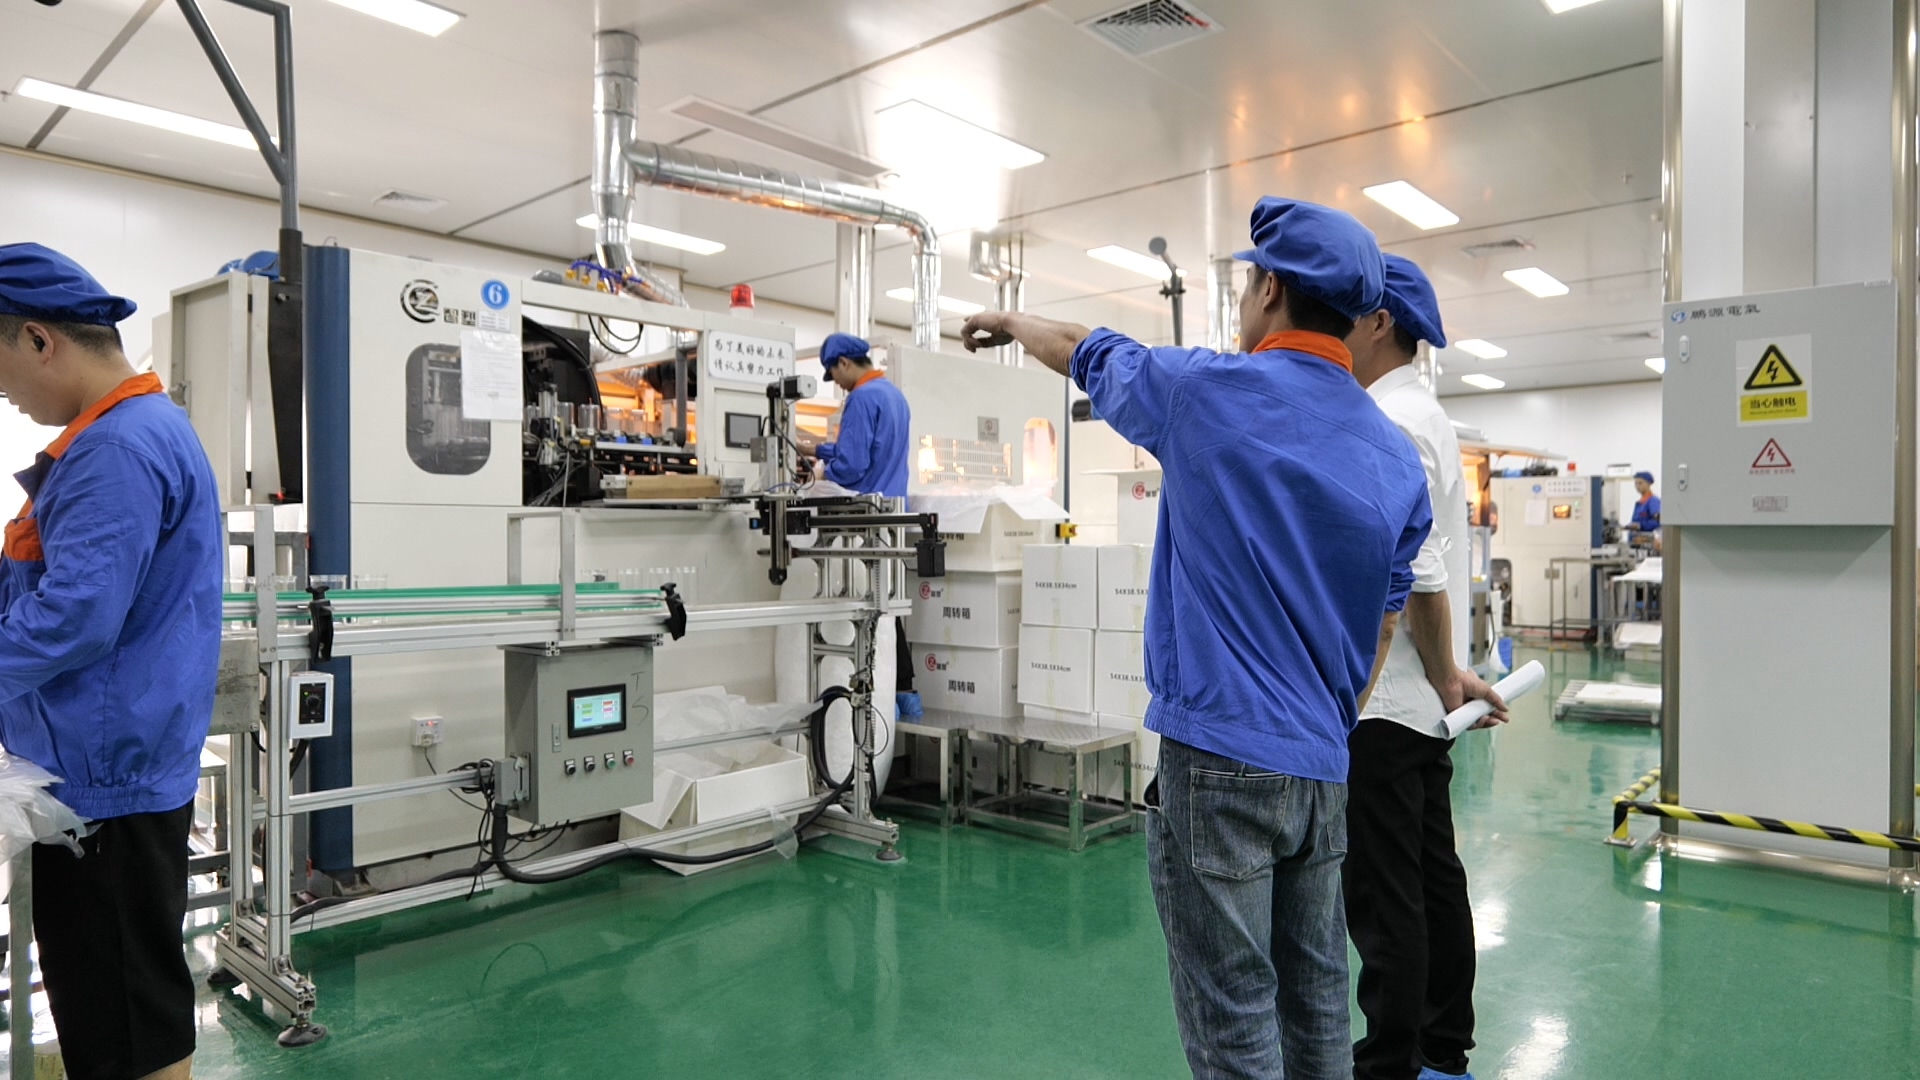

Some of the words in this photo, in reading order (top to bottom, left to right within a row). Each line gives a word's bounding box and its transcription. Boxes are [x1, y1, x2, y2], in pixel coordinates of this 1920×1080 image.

[487, 283, 503, 304] 6
[1750, 396, 1796, 409] 当心触电
[942, 606, 971, 620] 周转箱
[948, 679, 976, 695] 周转箱
